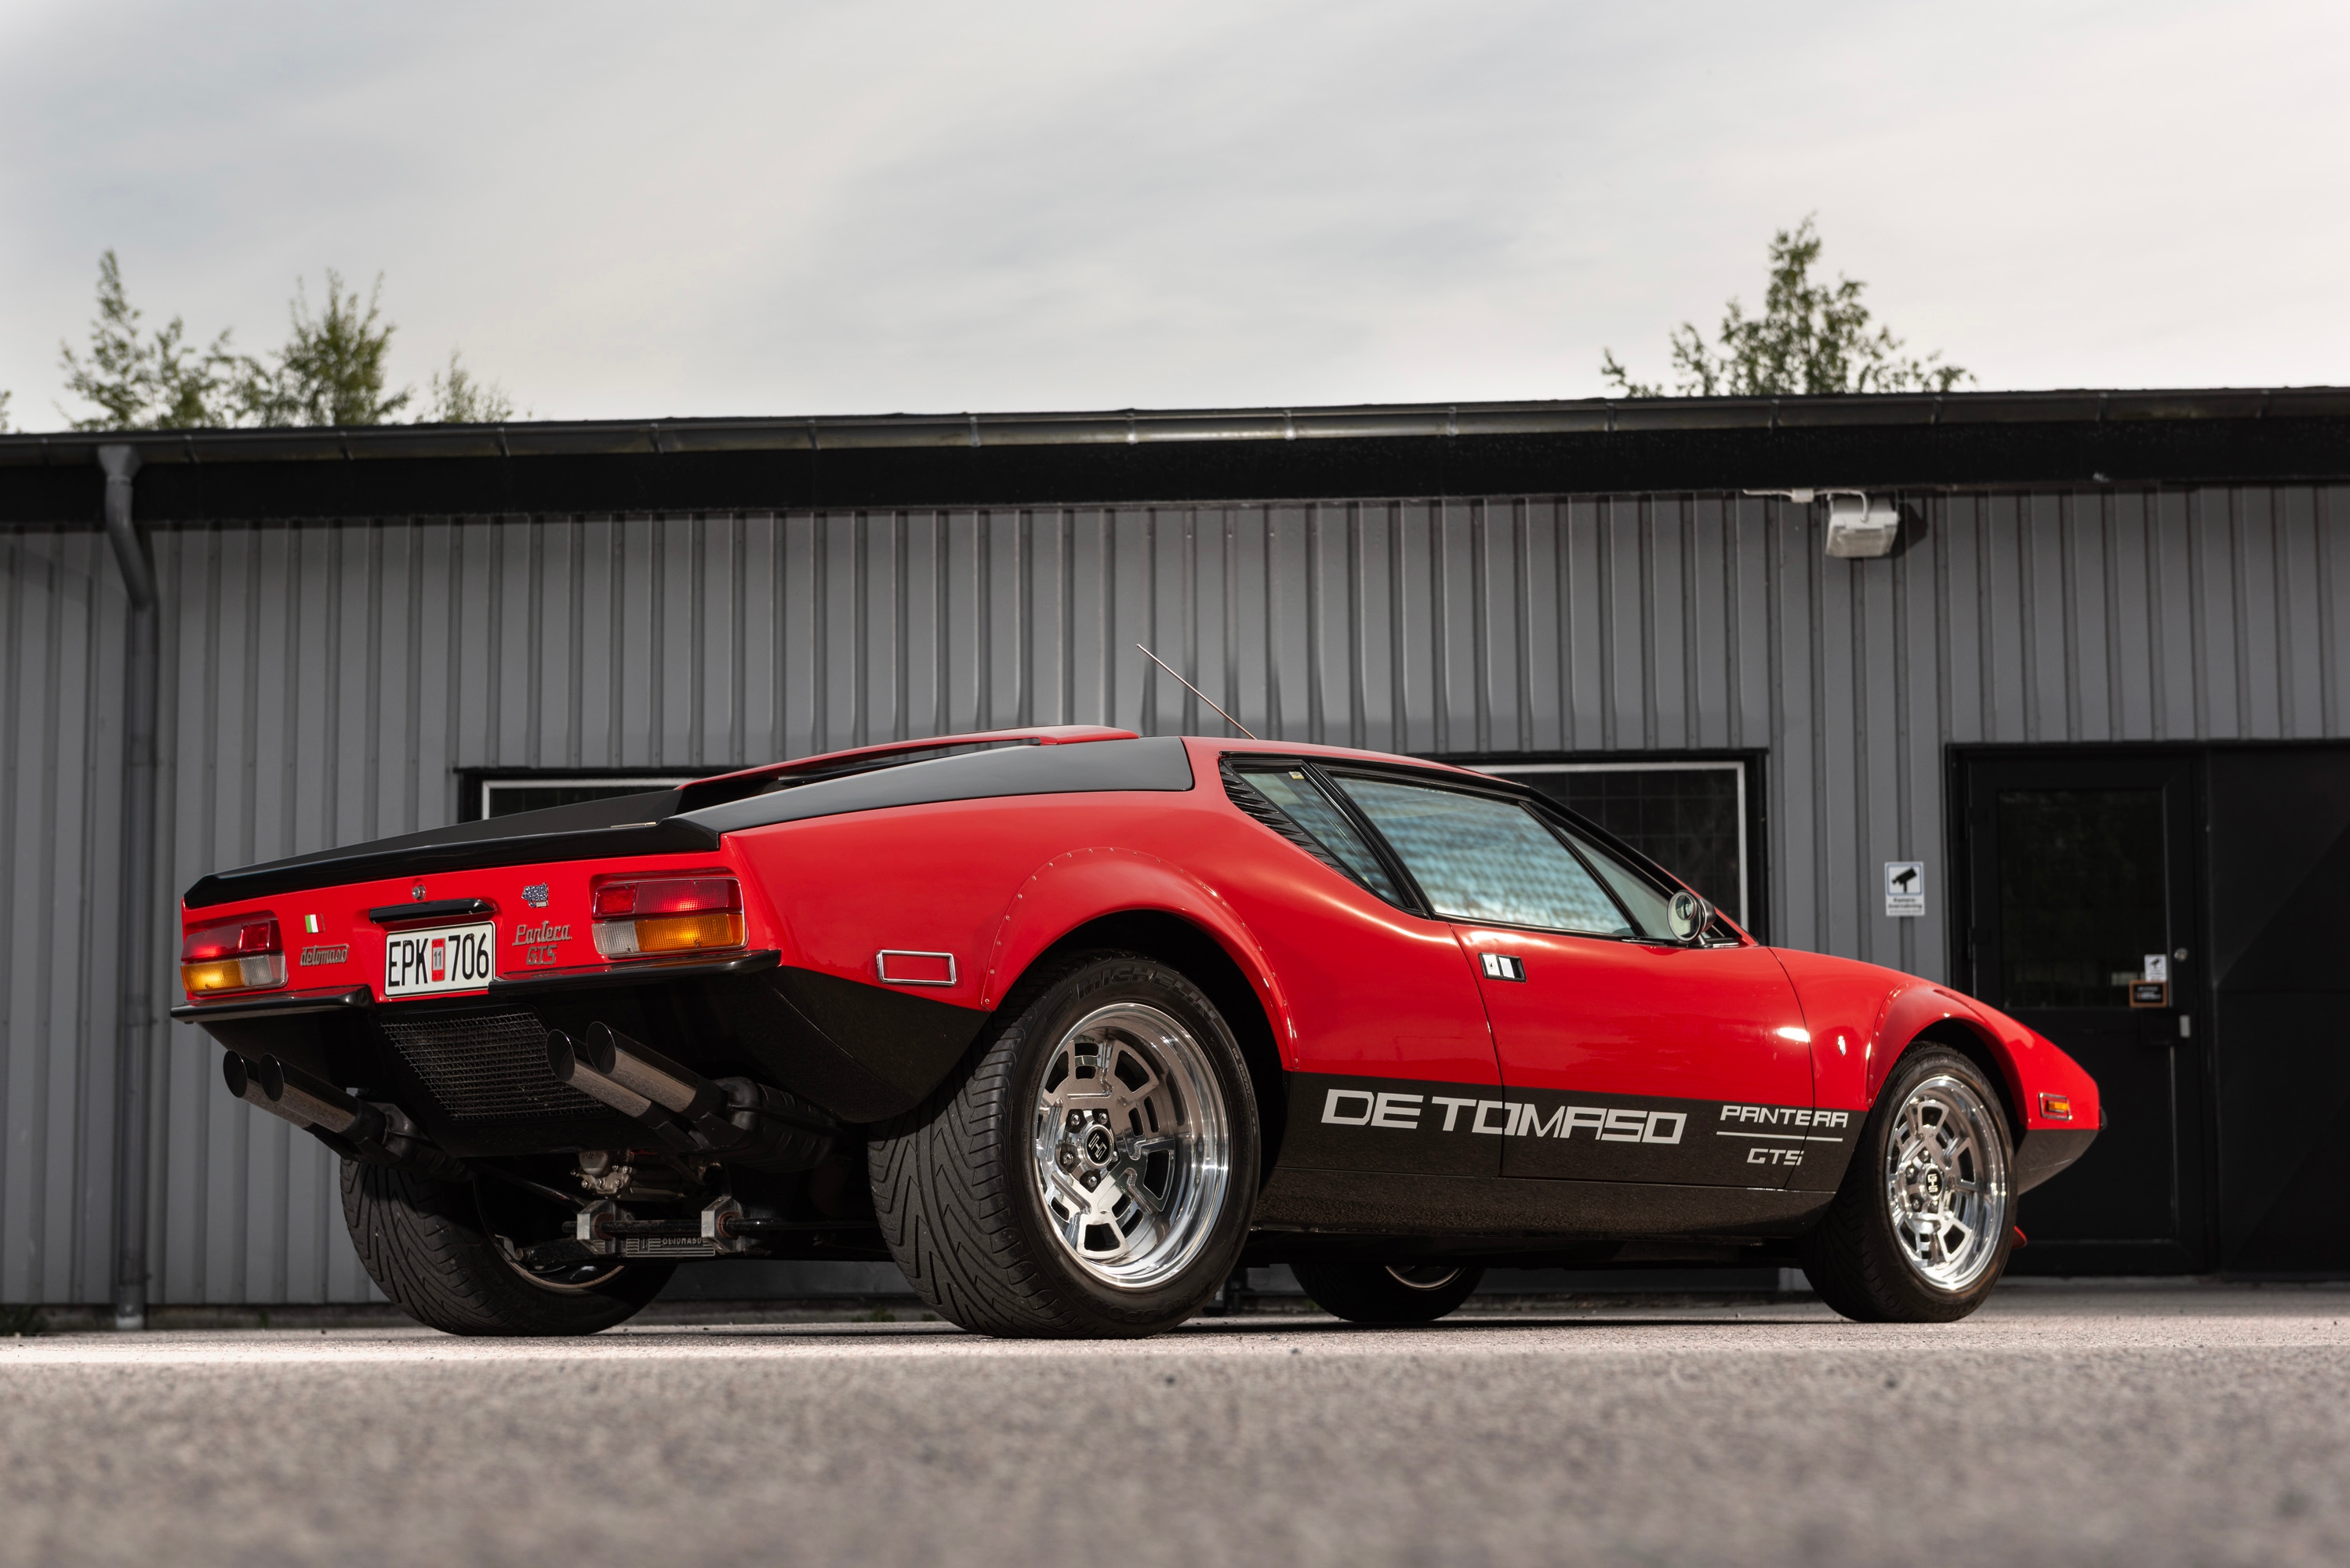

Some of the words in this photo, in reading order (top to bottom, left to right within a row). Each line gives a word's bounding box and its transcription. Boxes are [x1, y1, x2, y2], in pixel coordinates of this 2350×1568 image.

[512, 920, 572, 946] Pantera
[388, 938, 428, 987] EPK
[434, 951, 441, 967] 11
[449, 932, 489, 982] 706
[526, 945, 558, 965] GTS
[1076, 967, 1218, 1019] MICHELIN
[1720, 1105, 1849, 1128] PANTERA
[1746, 1148, 1804, 1166] GTS
